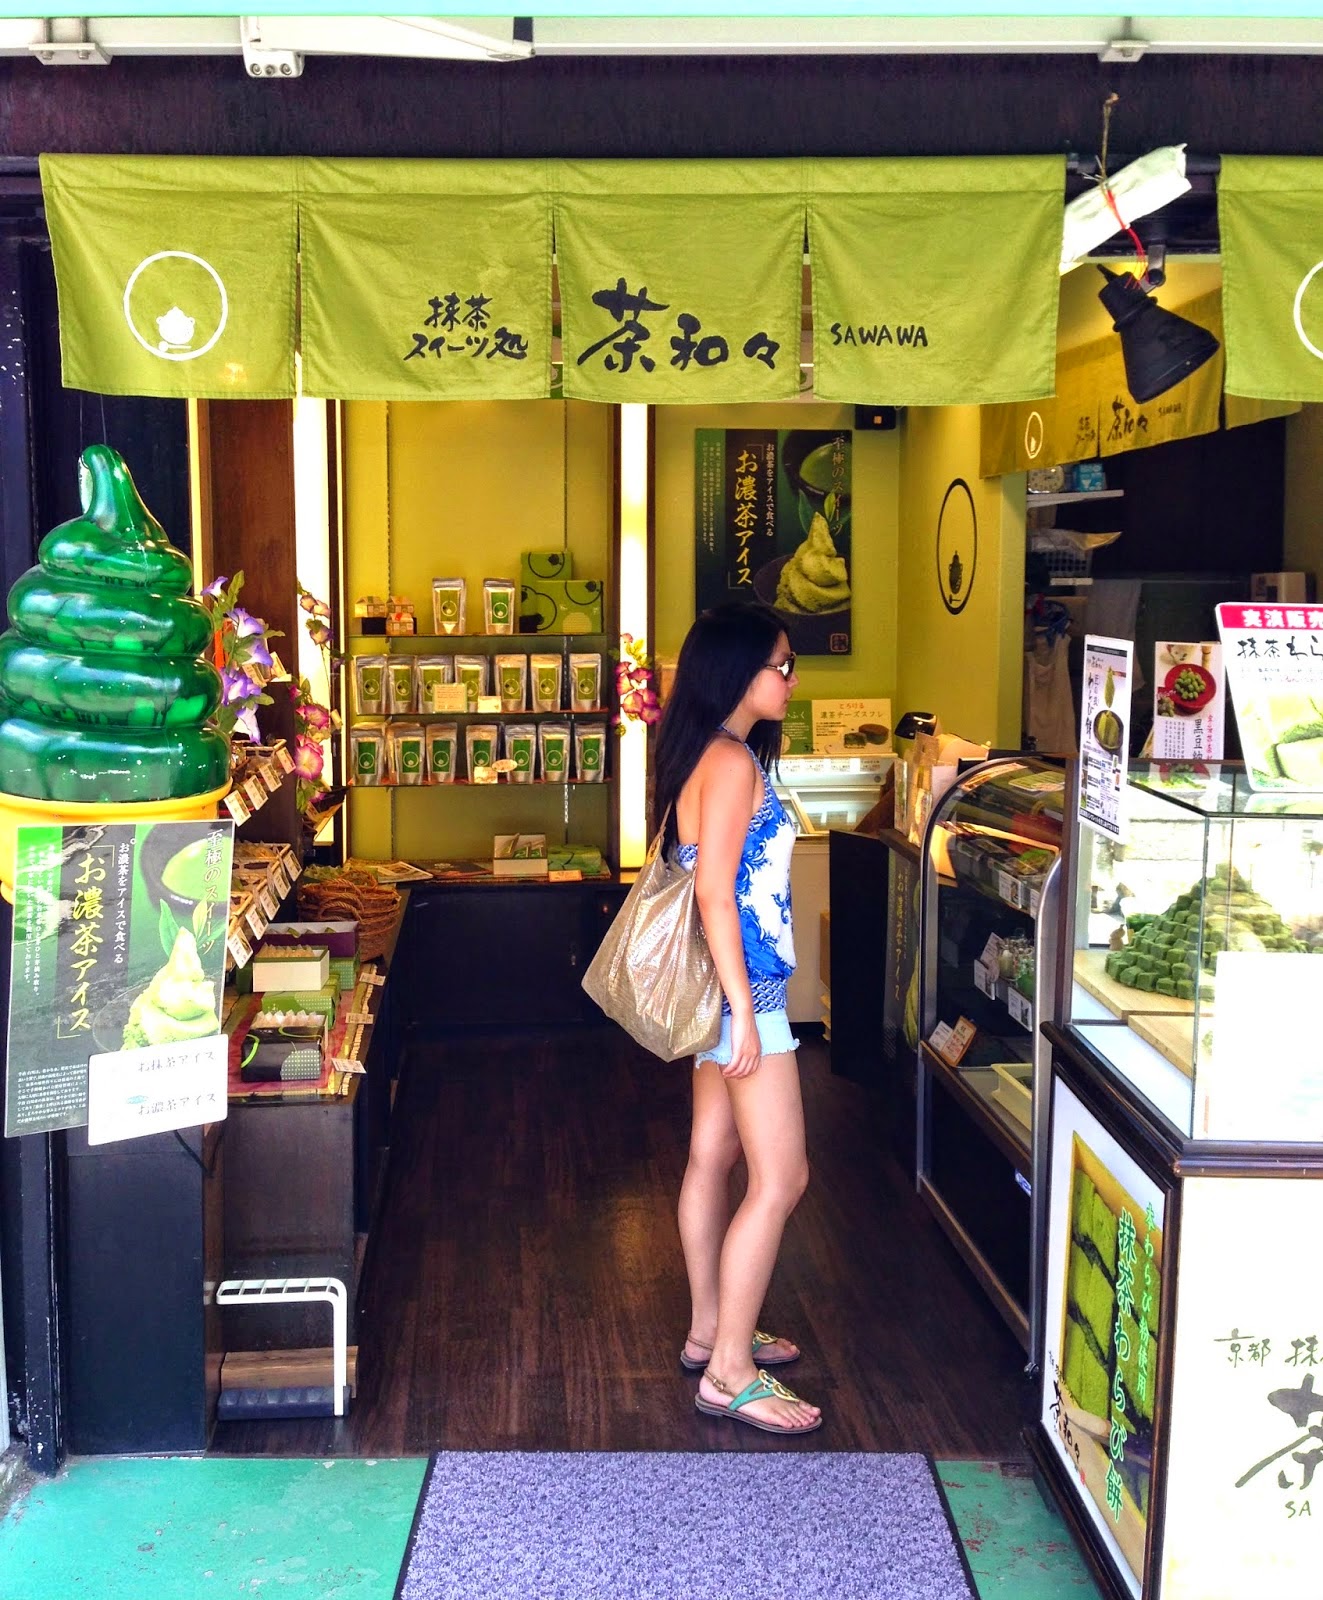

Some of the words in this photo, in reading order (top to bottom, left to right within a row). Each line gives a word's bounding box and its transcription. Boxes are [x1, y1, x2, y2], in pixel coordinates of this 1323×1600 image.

[403, 327, 529, 361] スイーツ処
[424, 292, 493, 331] 抹茶
[577, 278, 780, 373] 茶和々
[830, 322, 928, 349] SAWAWA
[765, 443, 775, 537] お濃茶をアイスで食べる
[113, 842, 130, 965] お濃茶をアイスで食べる
[201, 828, 224, 956] 至極のスイーツ
[1105, 1206, 1137, 1523] 抹茶わらび餅
[1213, 1328, 1271, 1368] 京都
[1285, 1335, 1323, 1367] 抹
